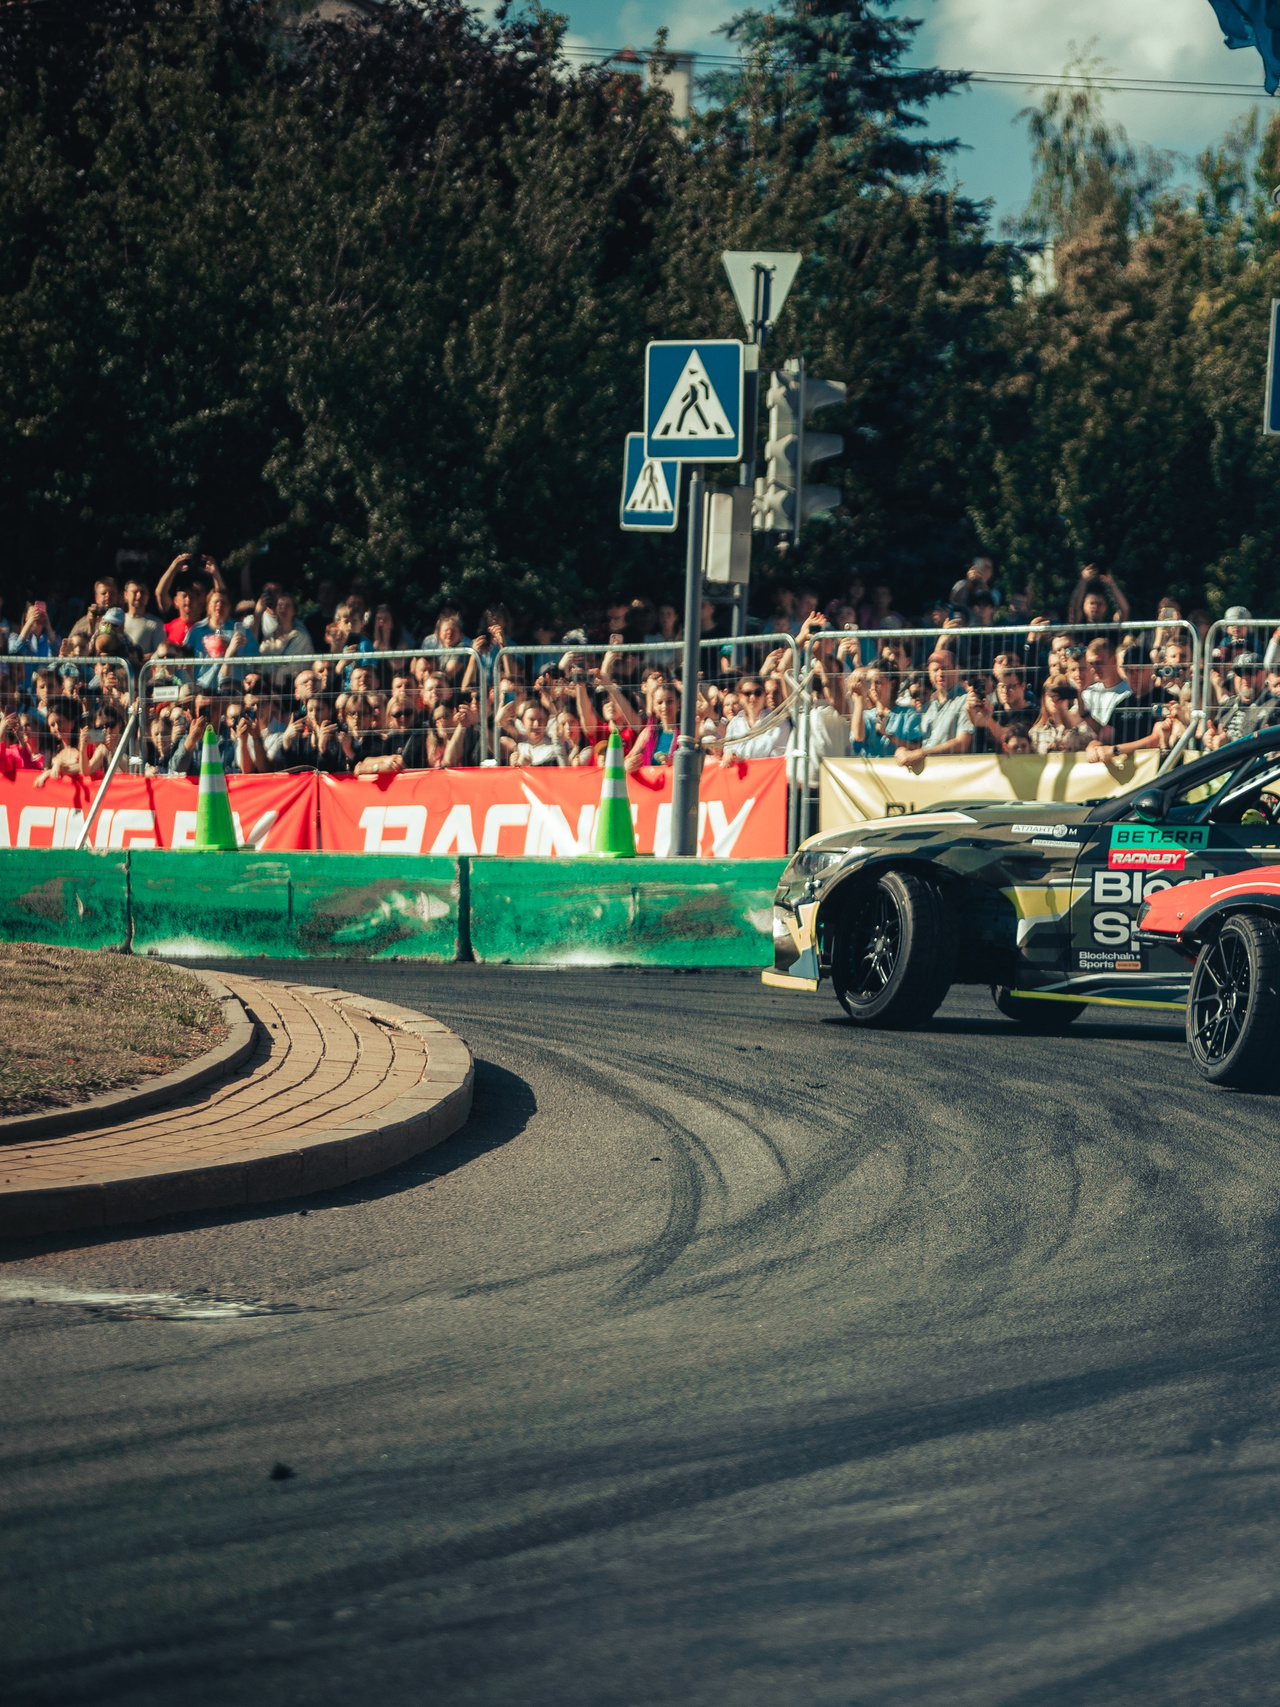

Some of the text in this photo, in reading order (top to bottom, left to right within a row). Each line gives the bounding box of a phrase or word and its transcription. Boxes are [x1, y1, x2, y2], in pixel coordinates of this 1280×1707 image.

[1117, 830, 1204, 844] BET.ERA
[1079, 951, 1135, 960] Blockchain
[1079, 960, 1114, 970] Sports
